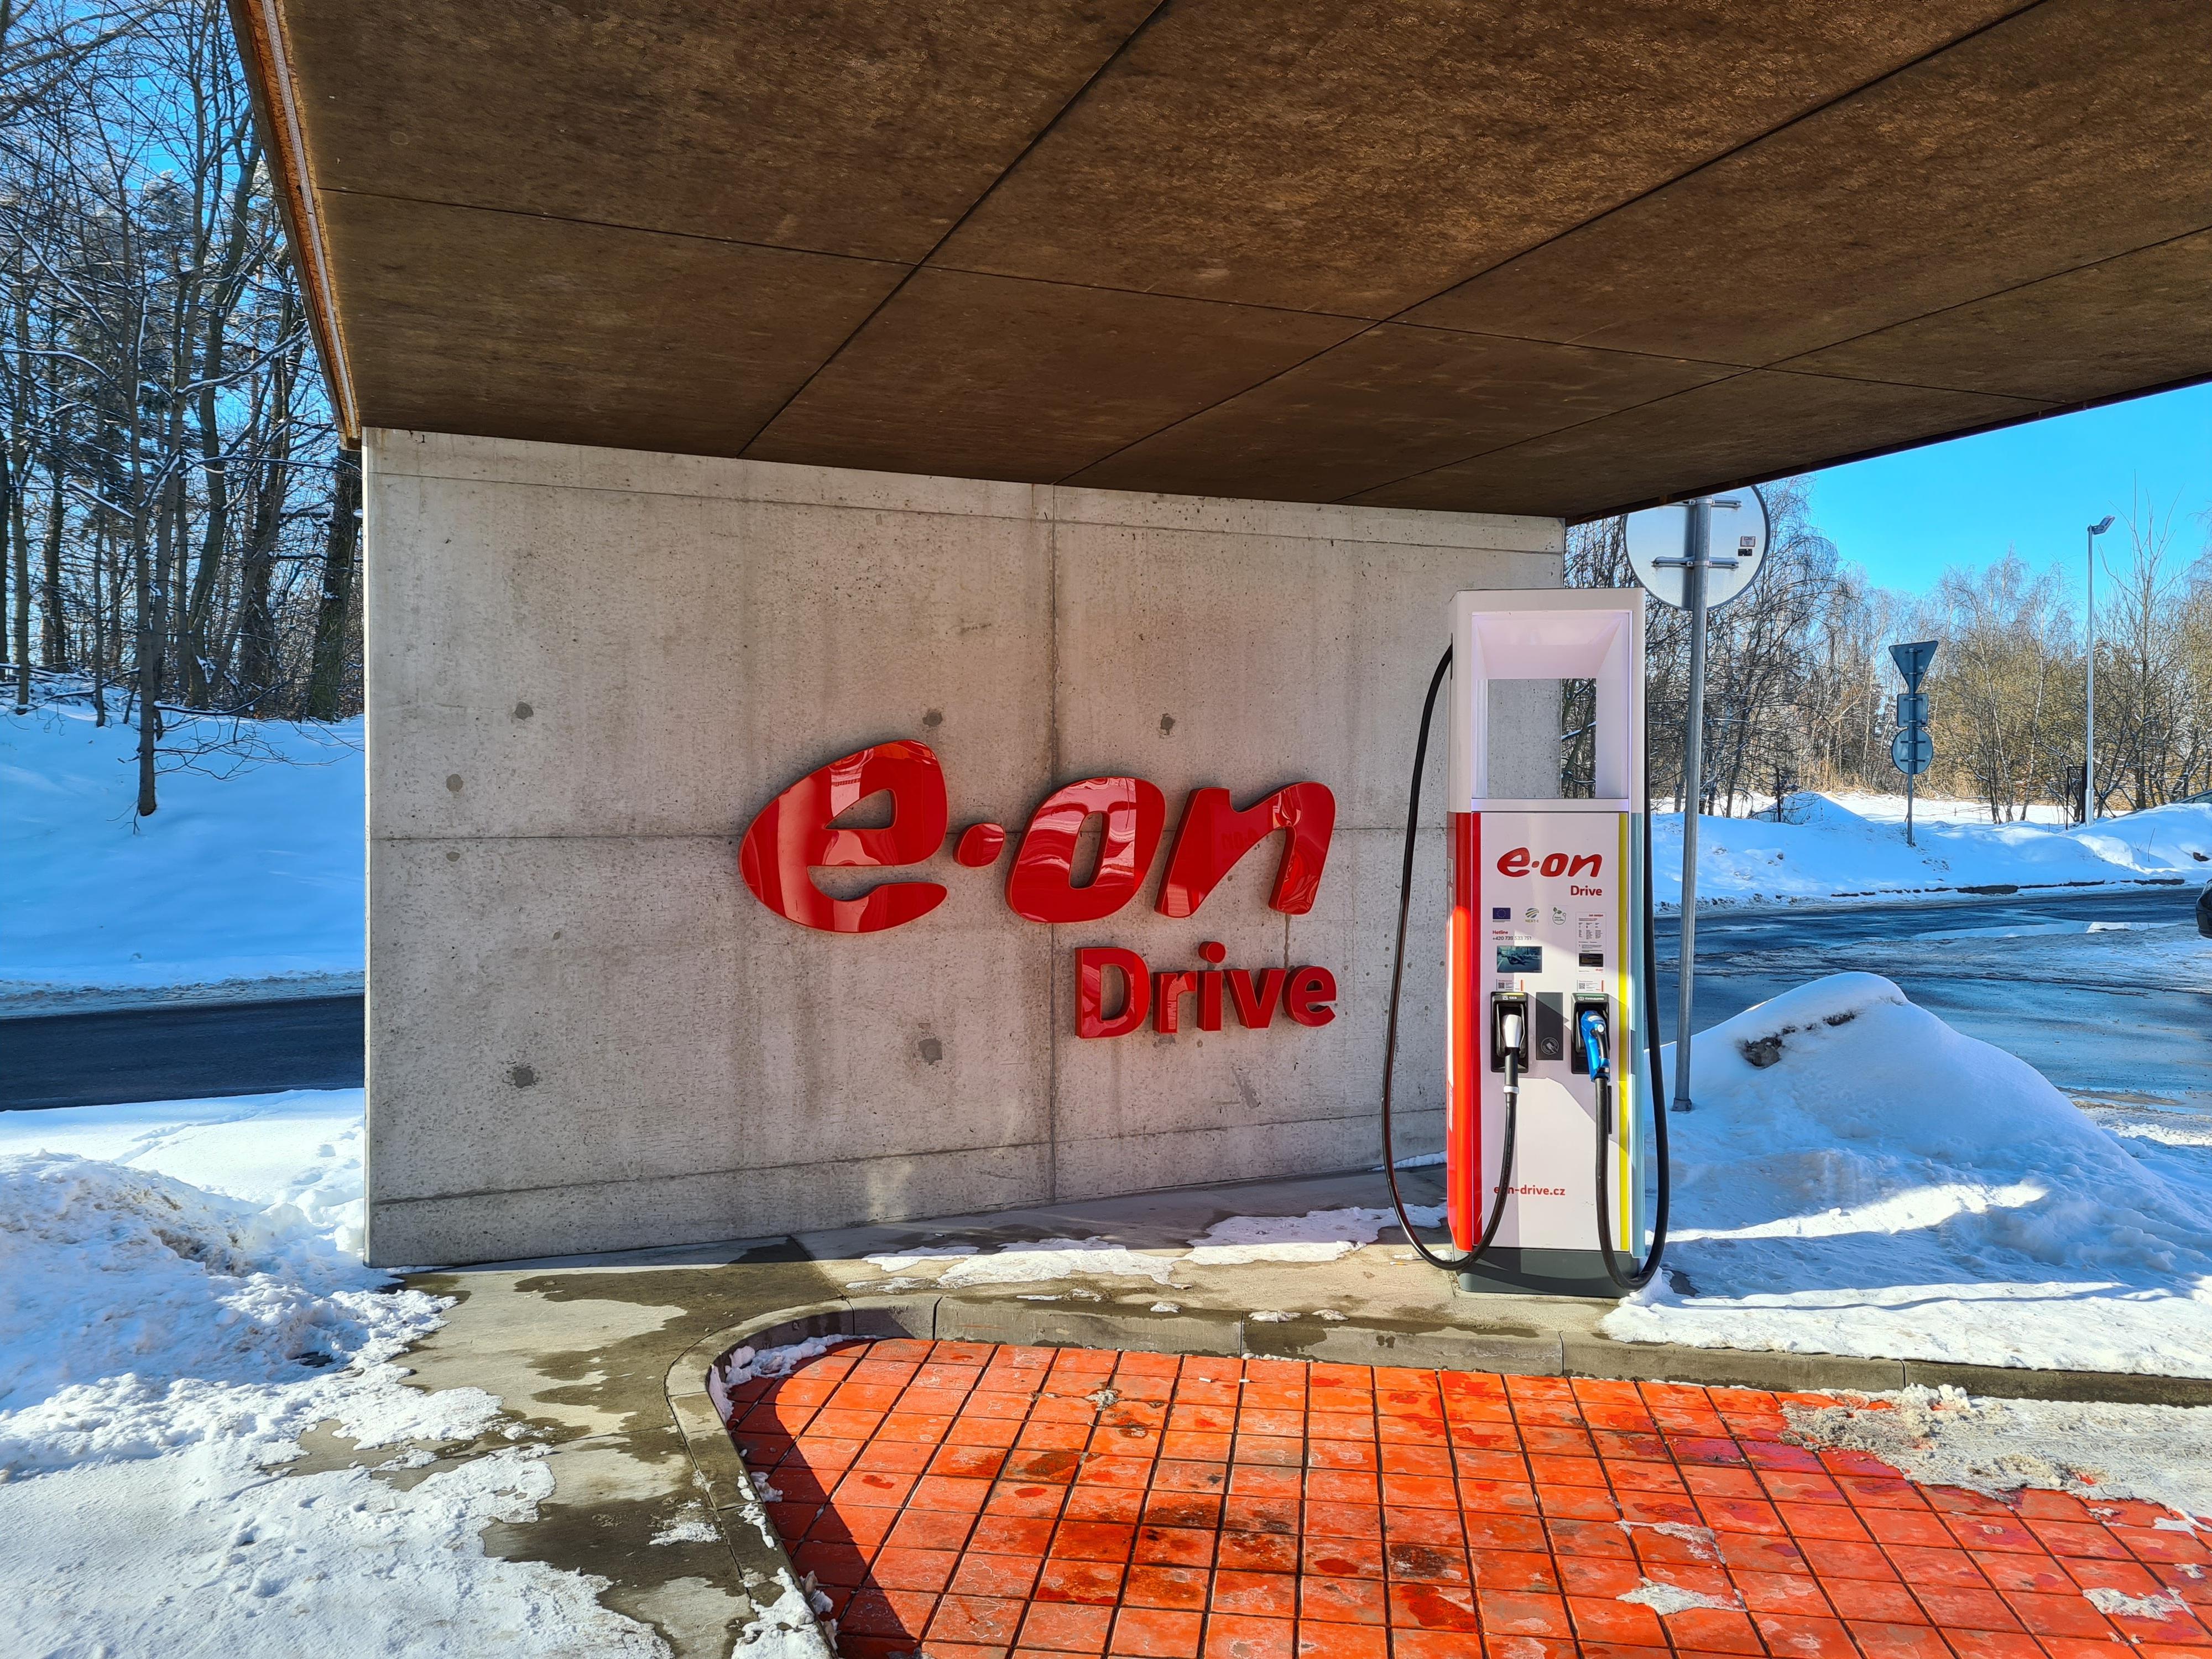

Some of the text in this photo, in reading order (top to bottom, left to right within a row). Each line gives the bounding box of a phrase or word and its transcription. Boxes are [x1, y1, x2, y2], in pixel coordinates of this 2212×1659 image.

[1570, 885, 1603, 896] Drive
[1074, 941, 1337, 1039] Drive
[1493, 1185, 1566, 1196] en-drive.cz
